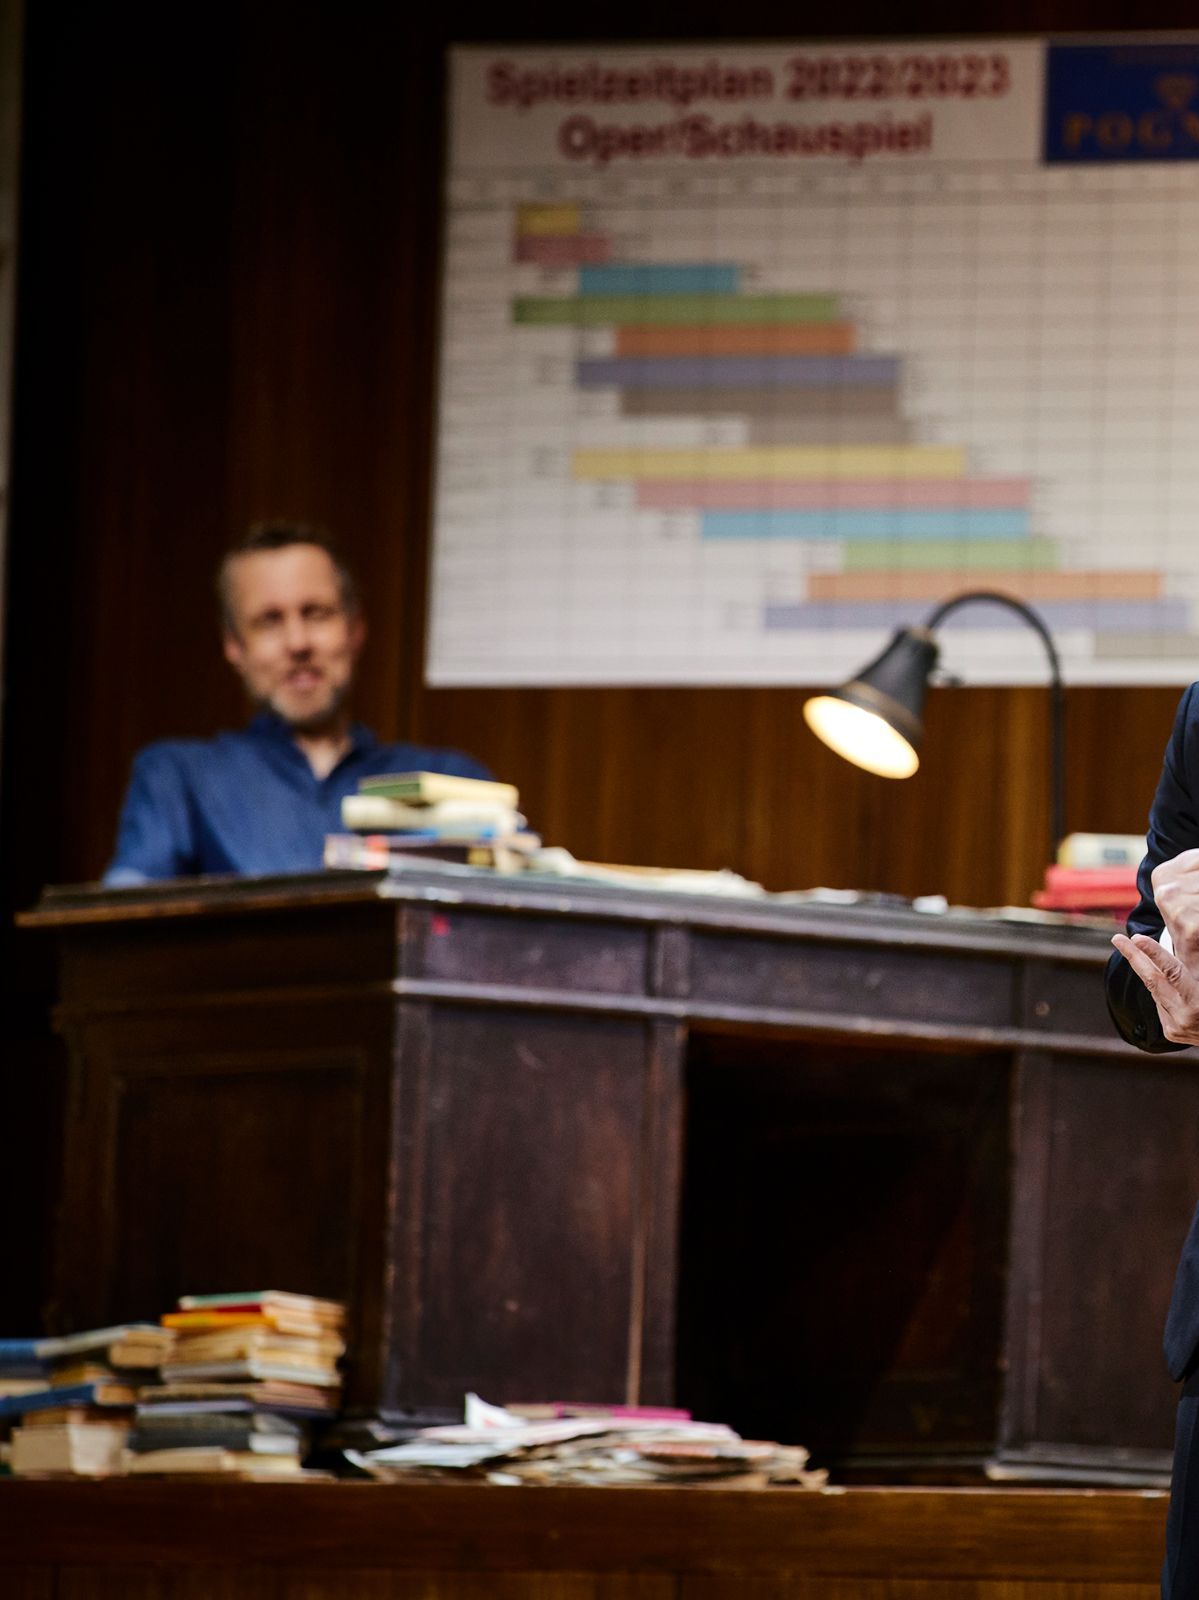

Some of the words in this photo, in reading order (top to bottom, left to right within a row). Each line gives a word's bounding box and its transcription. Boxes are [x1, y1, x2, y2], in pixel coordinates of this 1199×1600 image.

[486, 58, 775, 114] Spielzeitplan
[784, 54, 1012, 101] 2022/2023
[559, 113, 933, 168] Oper/Schauspiel
